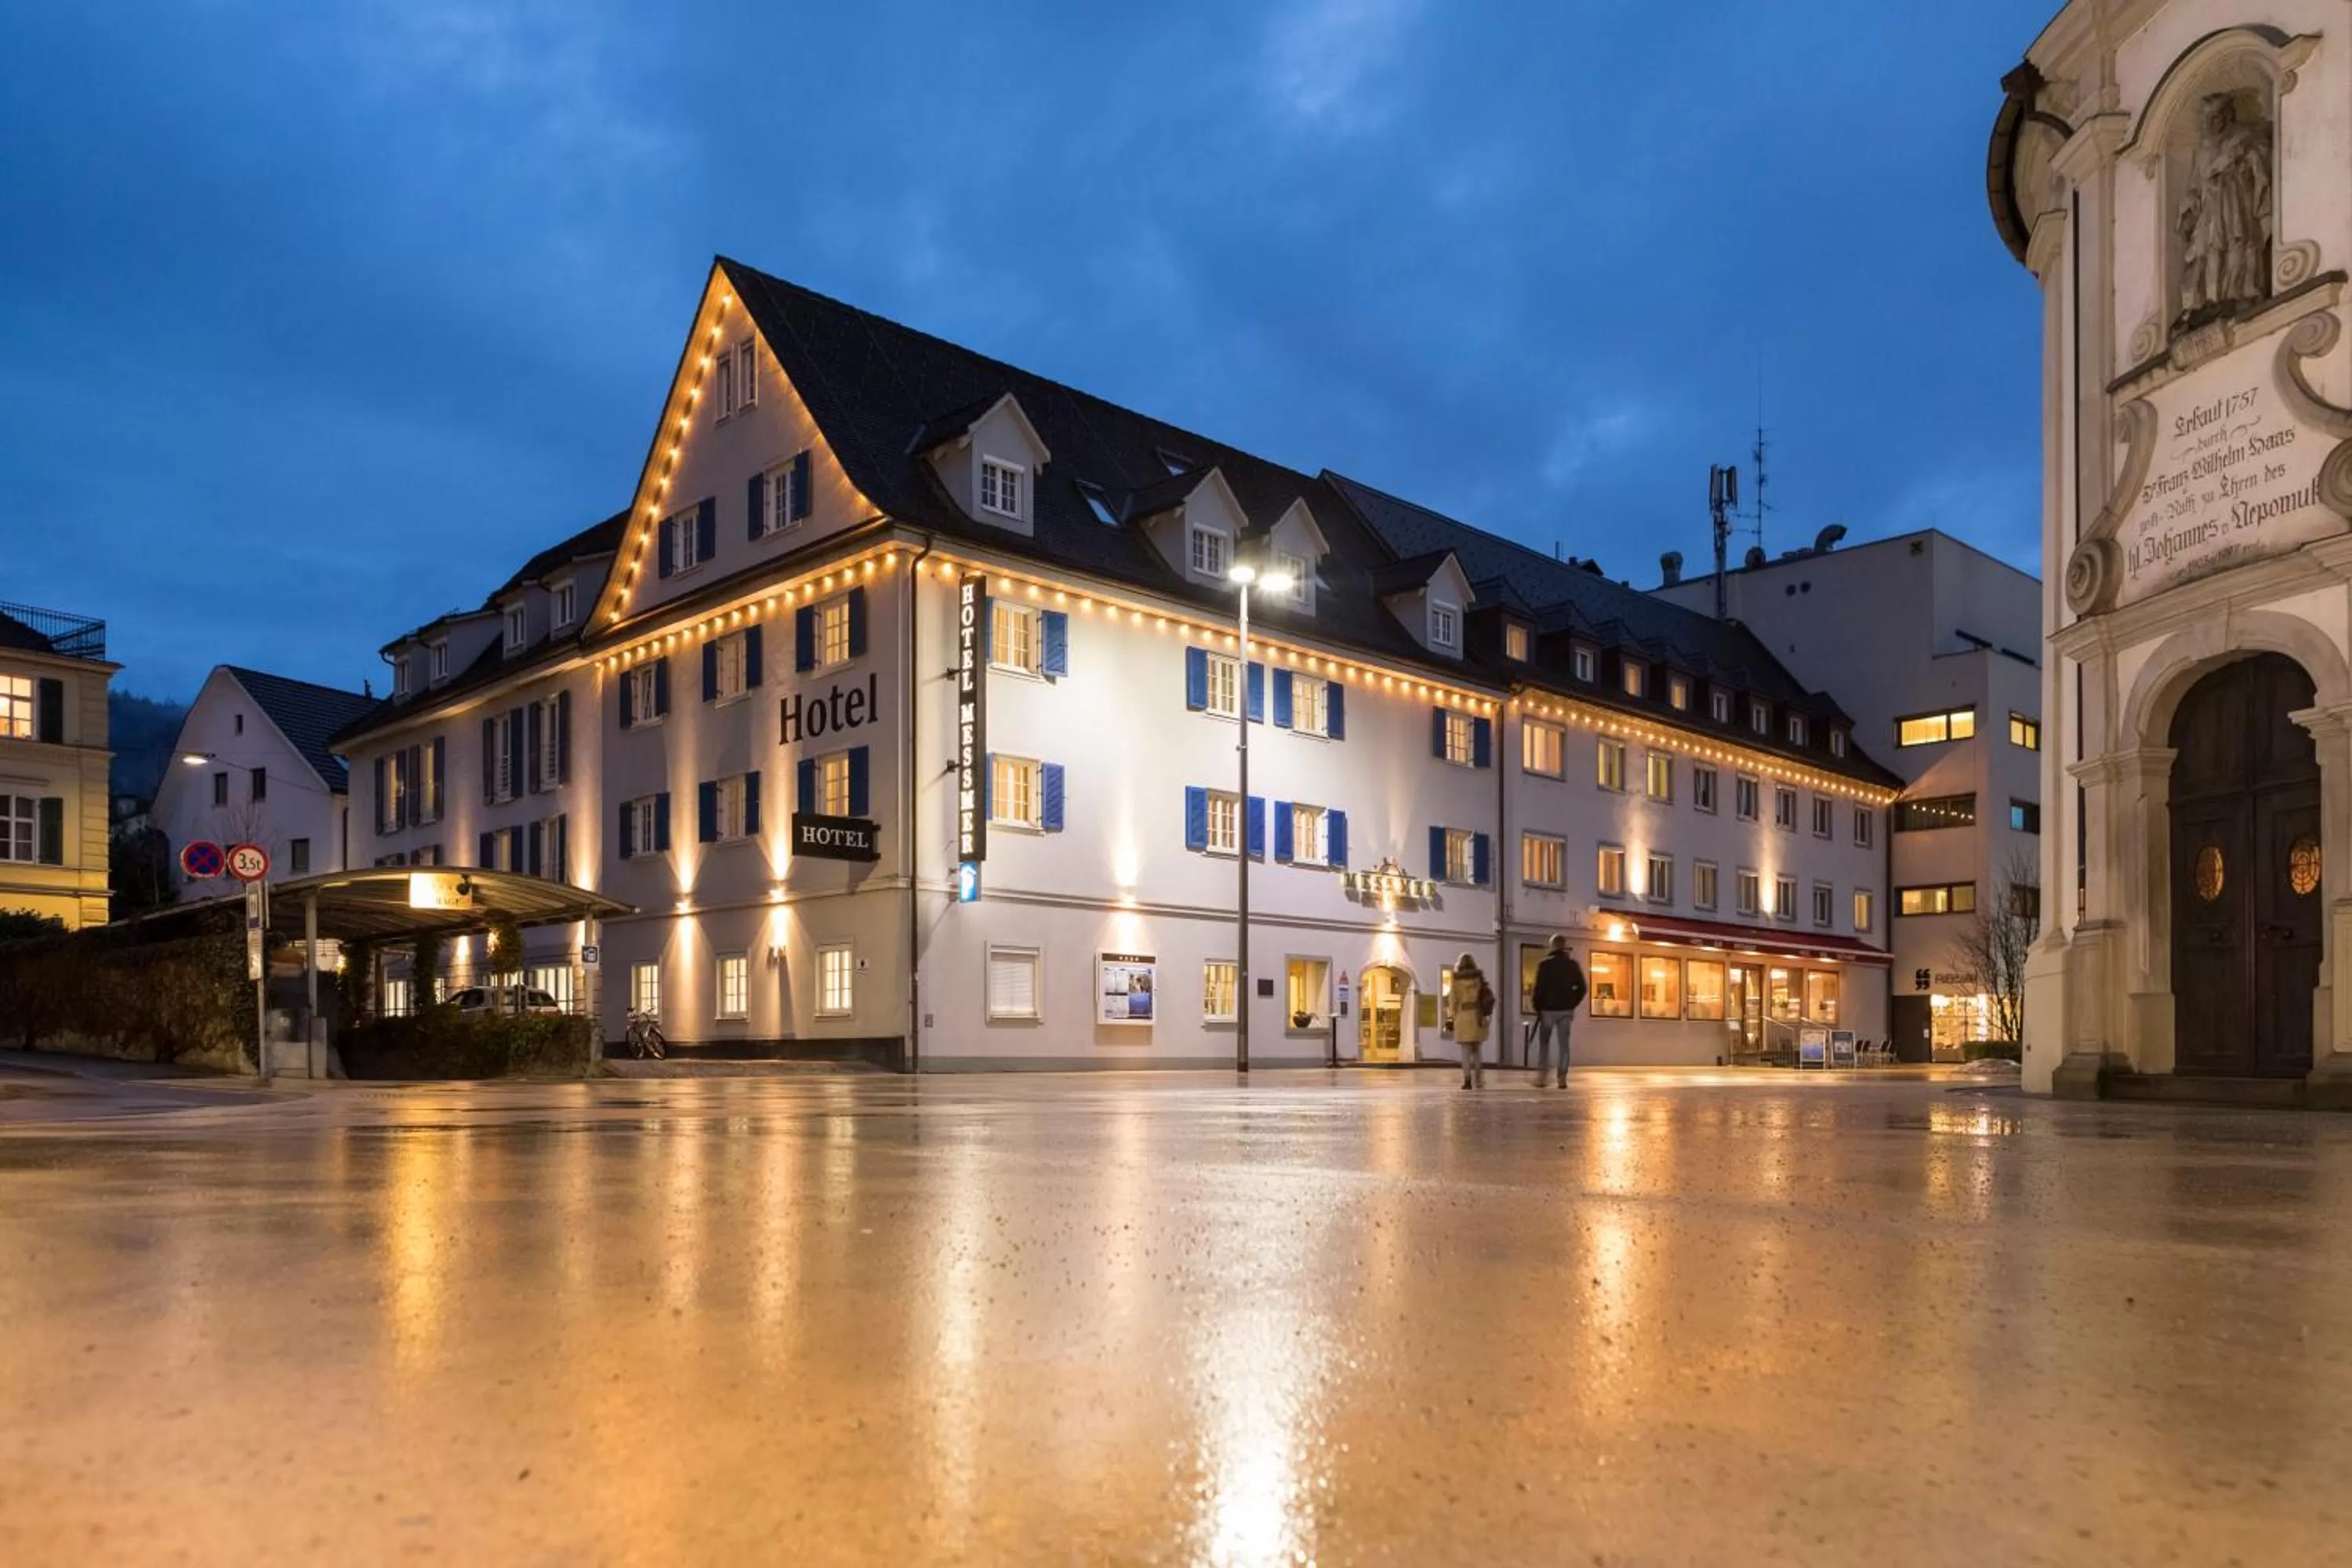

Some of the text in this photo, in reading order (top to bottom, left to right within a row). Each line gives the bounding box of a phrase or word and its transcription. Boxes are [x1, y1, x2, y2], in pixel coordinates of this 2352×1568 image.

[2226, 387, 2259, 419] 1757
[2192, 445, 2245, 480] Wilhelm
[2248, 426, 2296, 456] Haas
[2219, 472, 2257, 499] Ehren
[2264, 463, 2286, 483] des
[2144, 519, 2219, 564] Johannes
[2231, 476, 2321, 529] Nepomuk
[779, 673, 879, 746] Hotel
[960, 584, 975, 854] HOTEL MESSMER
[802, 826, 869, 849] HOTEL
